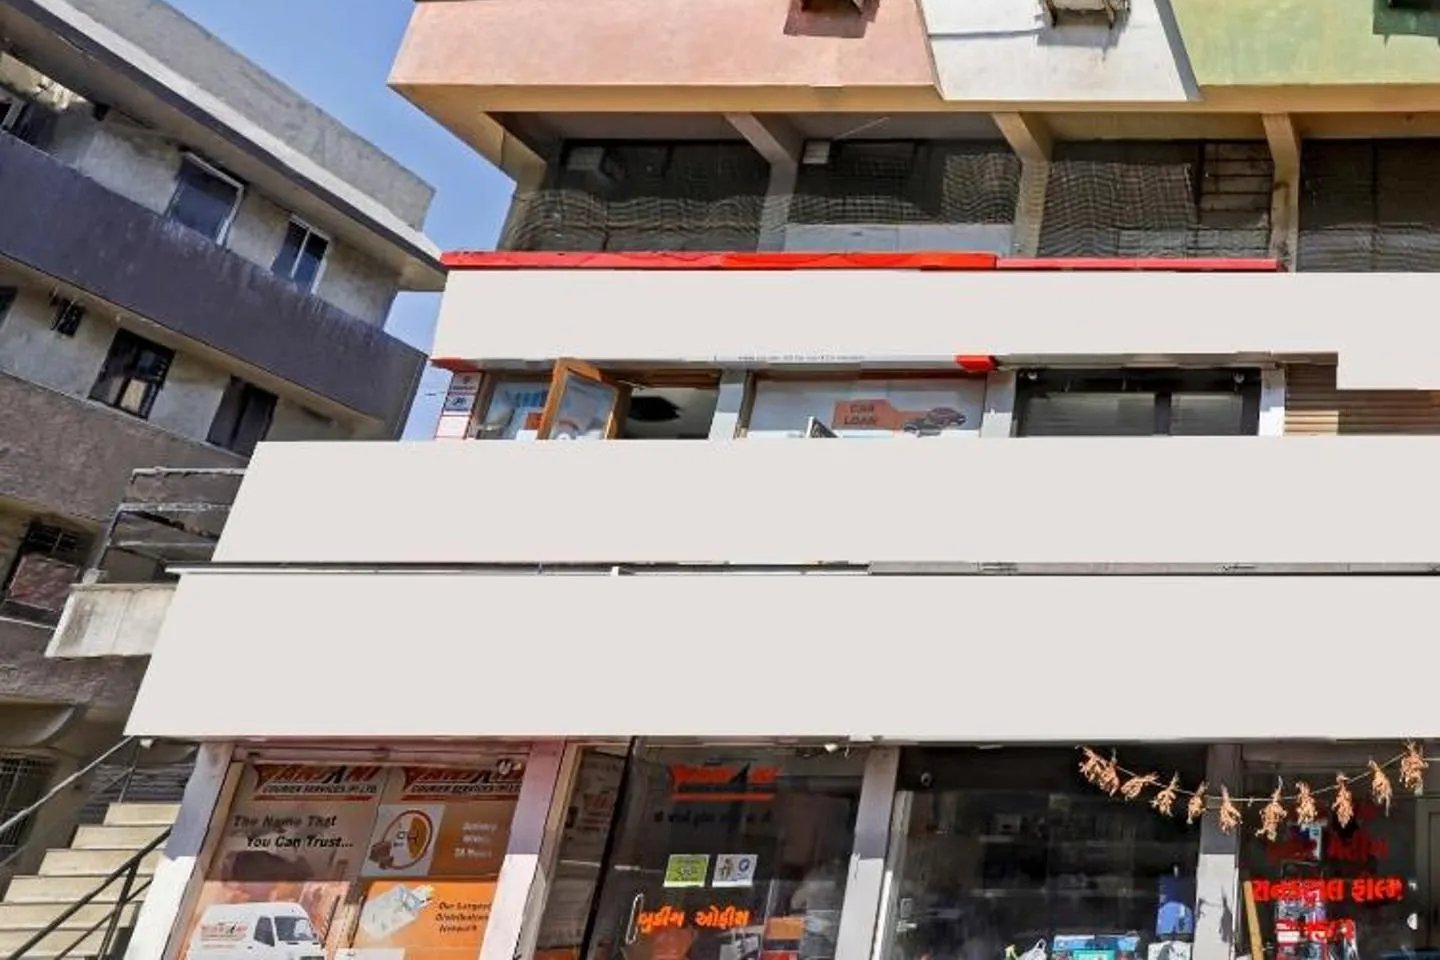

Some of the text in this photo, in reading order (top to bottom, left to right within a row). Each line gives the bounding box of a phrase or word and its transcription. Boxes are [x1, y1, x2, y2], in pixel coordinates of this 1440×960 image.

[233, 815, 259, 827] The
[262, 815, 302, 827] Name
[246, 836, 271, 847] You
[274, 836, 301, 847] Can
